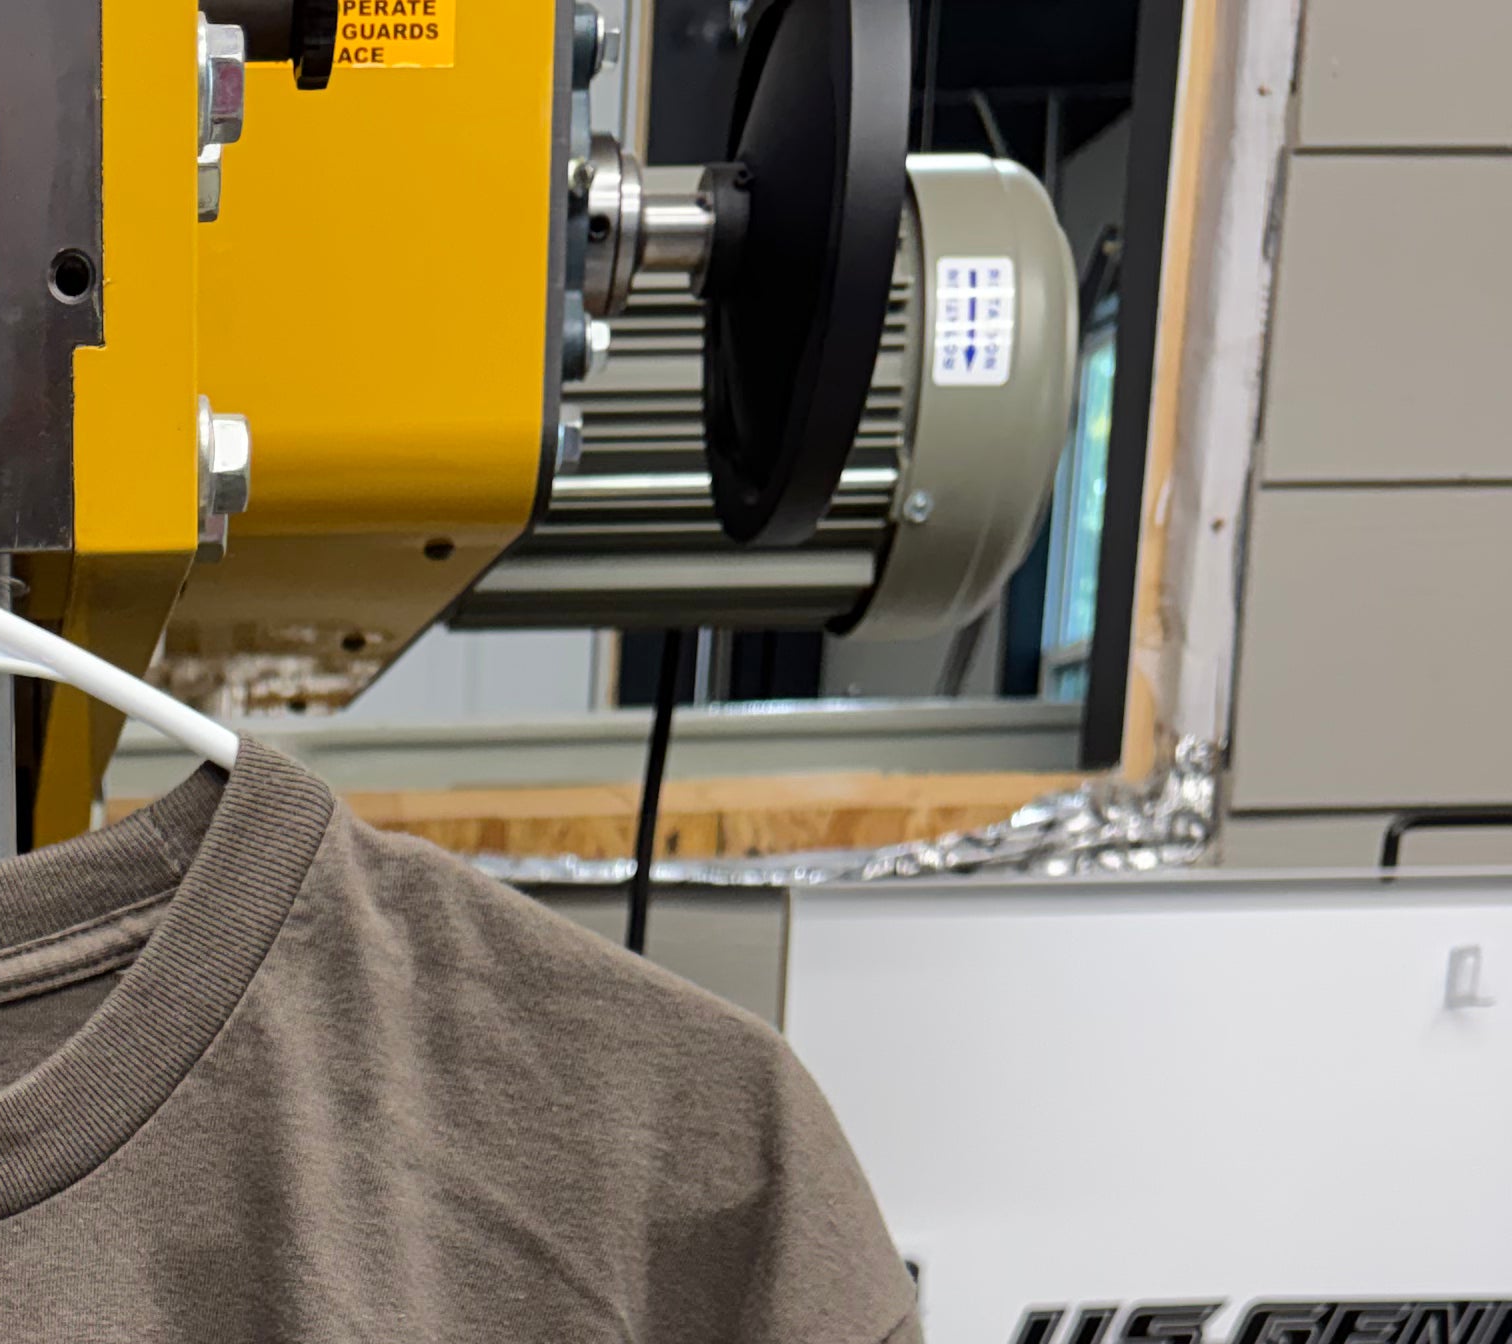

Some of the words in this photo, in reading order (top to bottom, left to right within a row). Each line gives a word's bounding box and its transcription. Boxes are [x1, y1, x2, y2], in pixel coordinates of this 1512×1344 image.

[337, 0, 437, 16] PERATE
[341, 23, 439, 40] GUARDS
[336, 47, 385, 63] ACE
